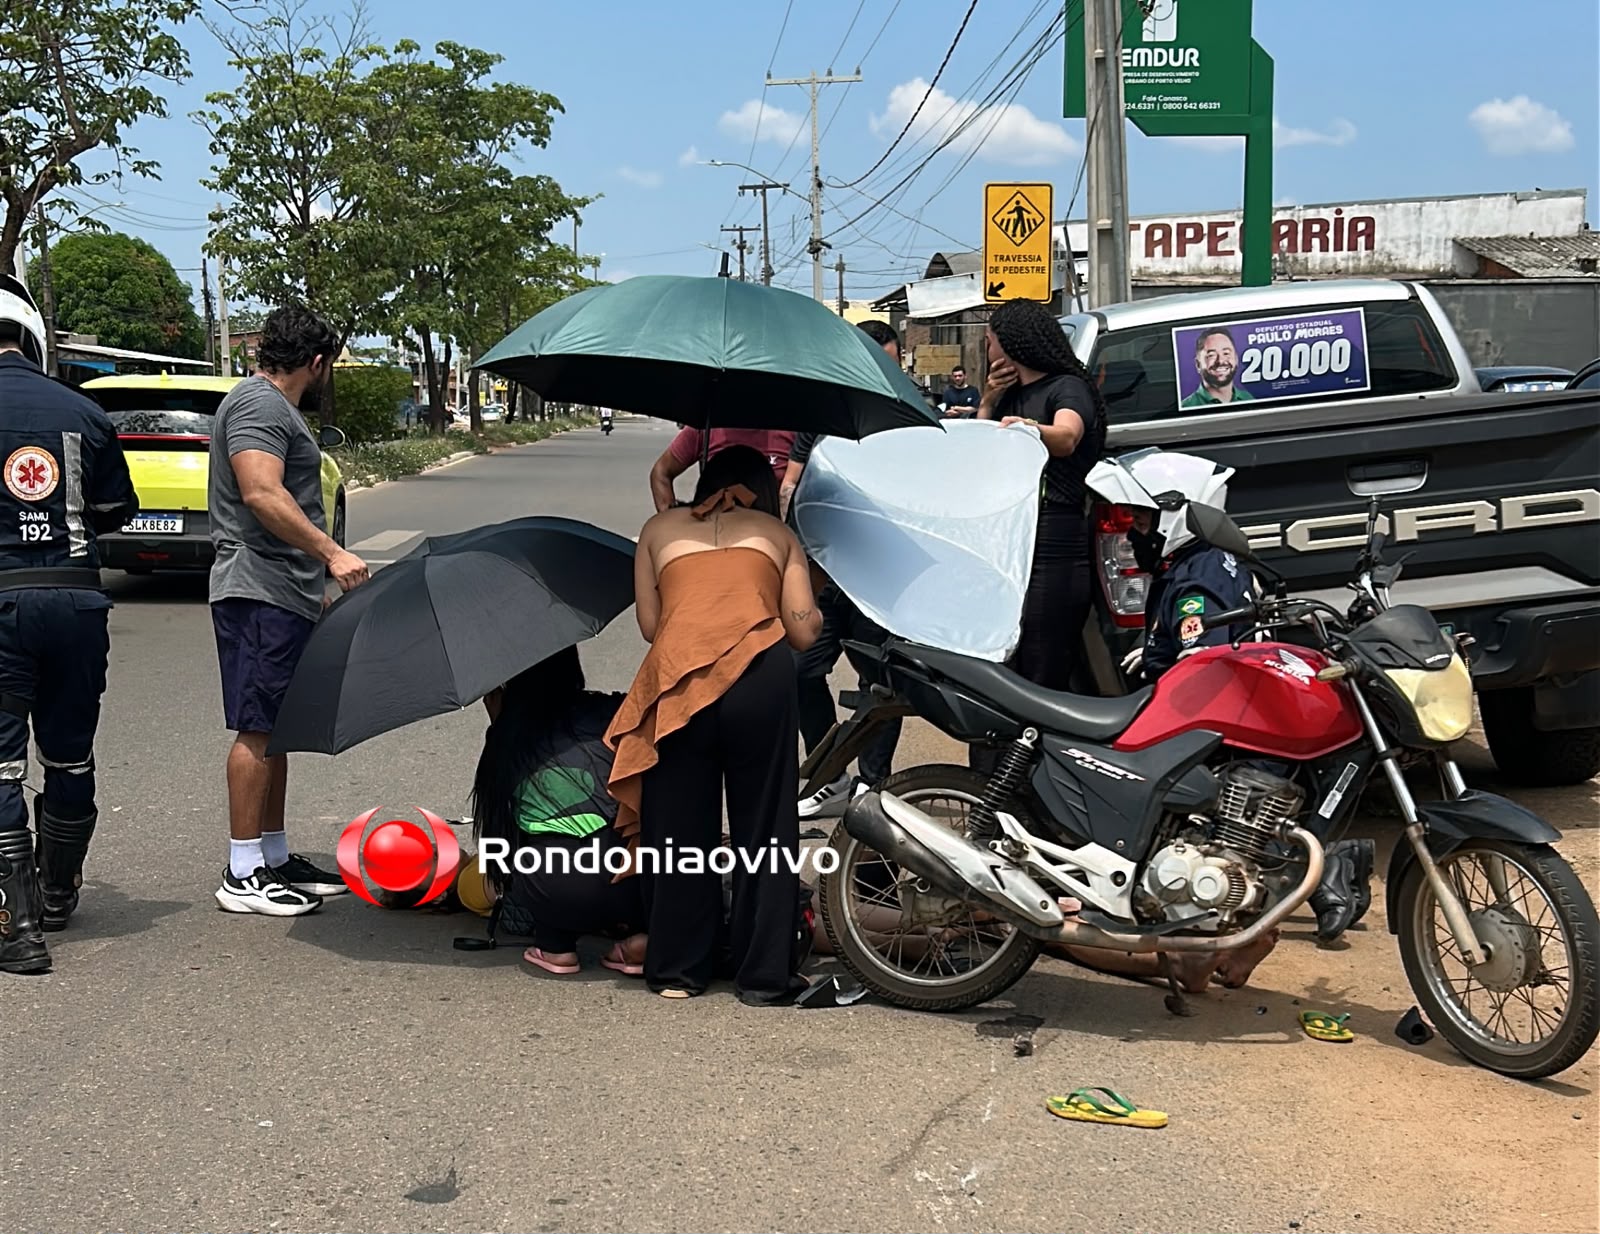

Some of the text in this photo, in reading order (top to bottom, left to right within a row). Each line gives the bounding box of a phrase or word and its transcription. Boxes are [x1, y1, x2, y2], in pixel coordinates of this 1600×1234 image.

[1122, 47, 1200, 67] EMDUR
[1183, 102, 1198, 110] 642
[993, 254, 1042, 262] TRAVESSIA
[989, 266, 1046, 274] DE PEDESTRE
[1255, 320, 1333, 333] DEPUTADO ESTADUAL
[1248, 325, 1344, 345] PAULO MORAES
[1241, 338, 1351, 383] 20.000
[18, 511, 49, 522] SAMU
[19, 524, 52, 541] 192
[1263, 659, 1310, 685] HONDA
